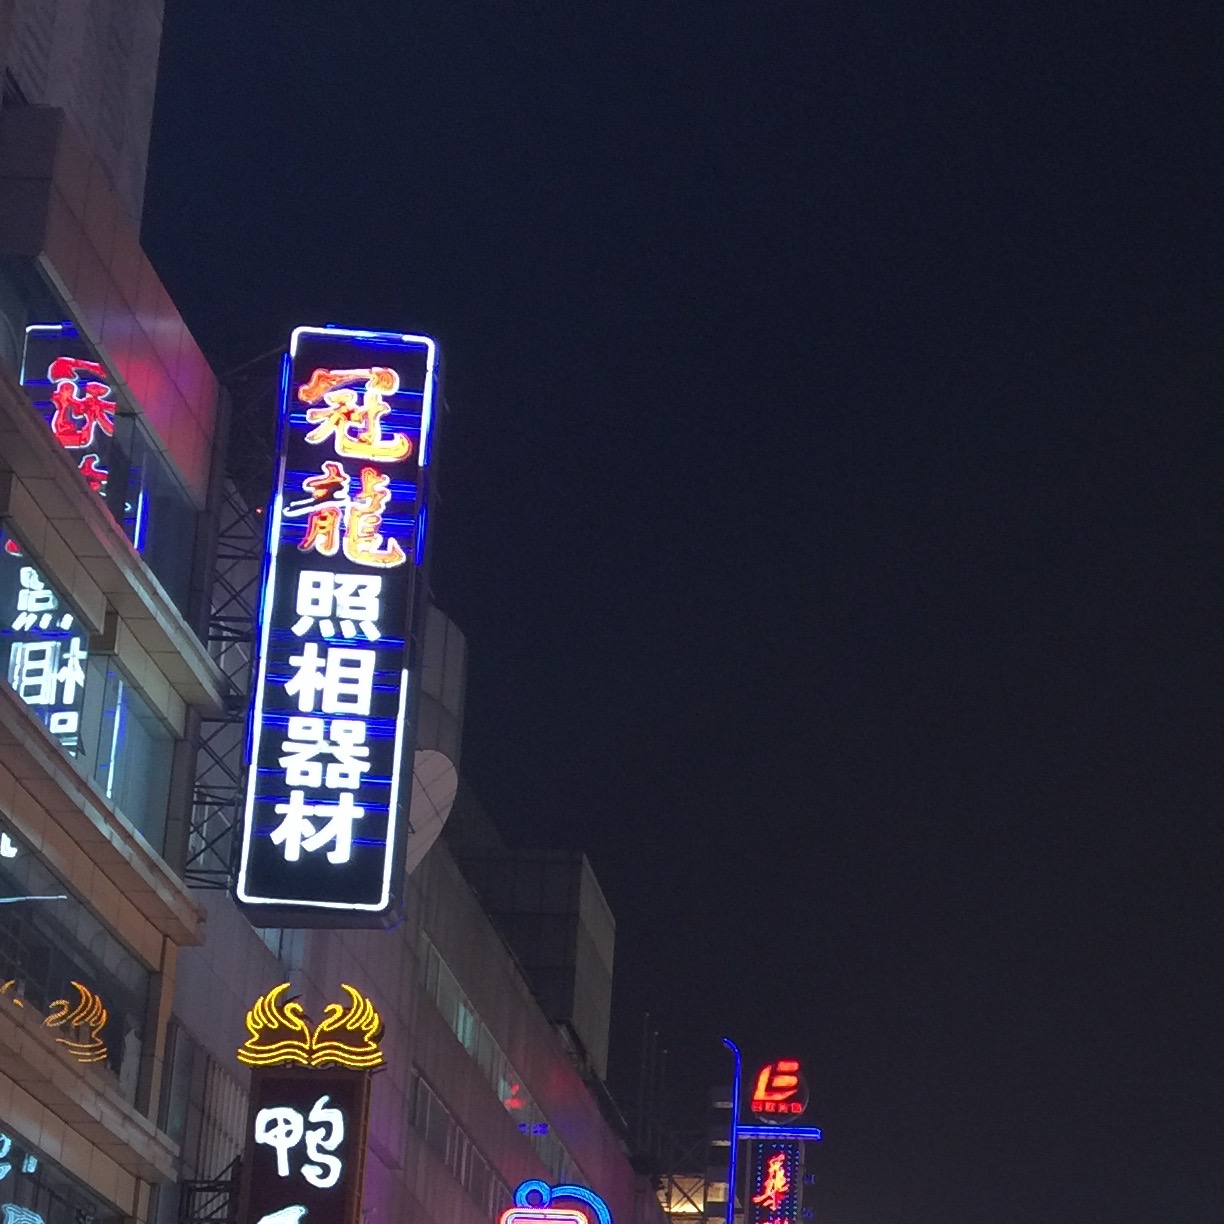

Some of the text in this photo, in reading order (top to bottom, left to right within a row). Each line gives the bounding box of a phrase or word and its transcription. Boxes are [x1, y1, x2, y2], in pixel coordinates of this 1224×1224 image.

[269, 366, 411, 866] 冠龍照相器材
